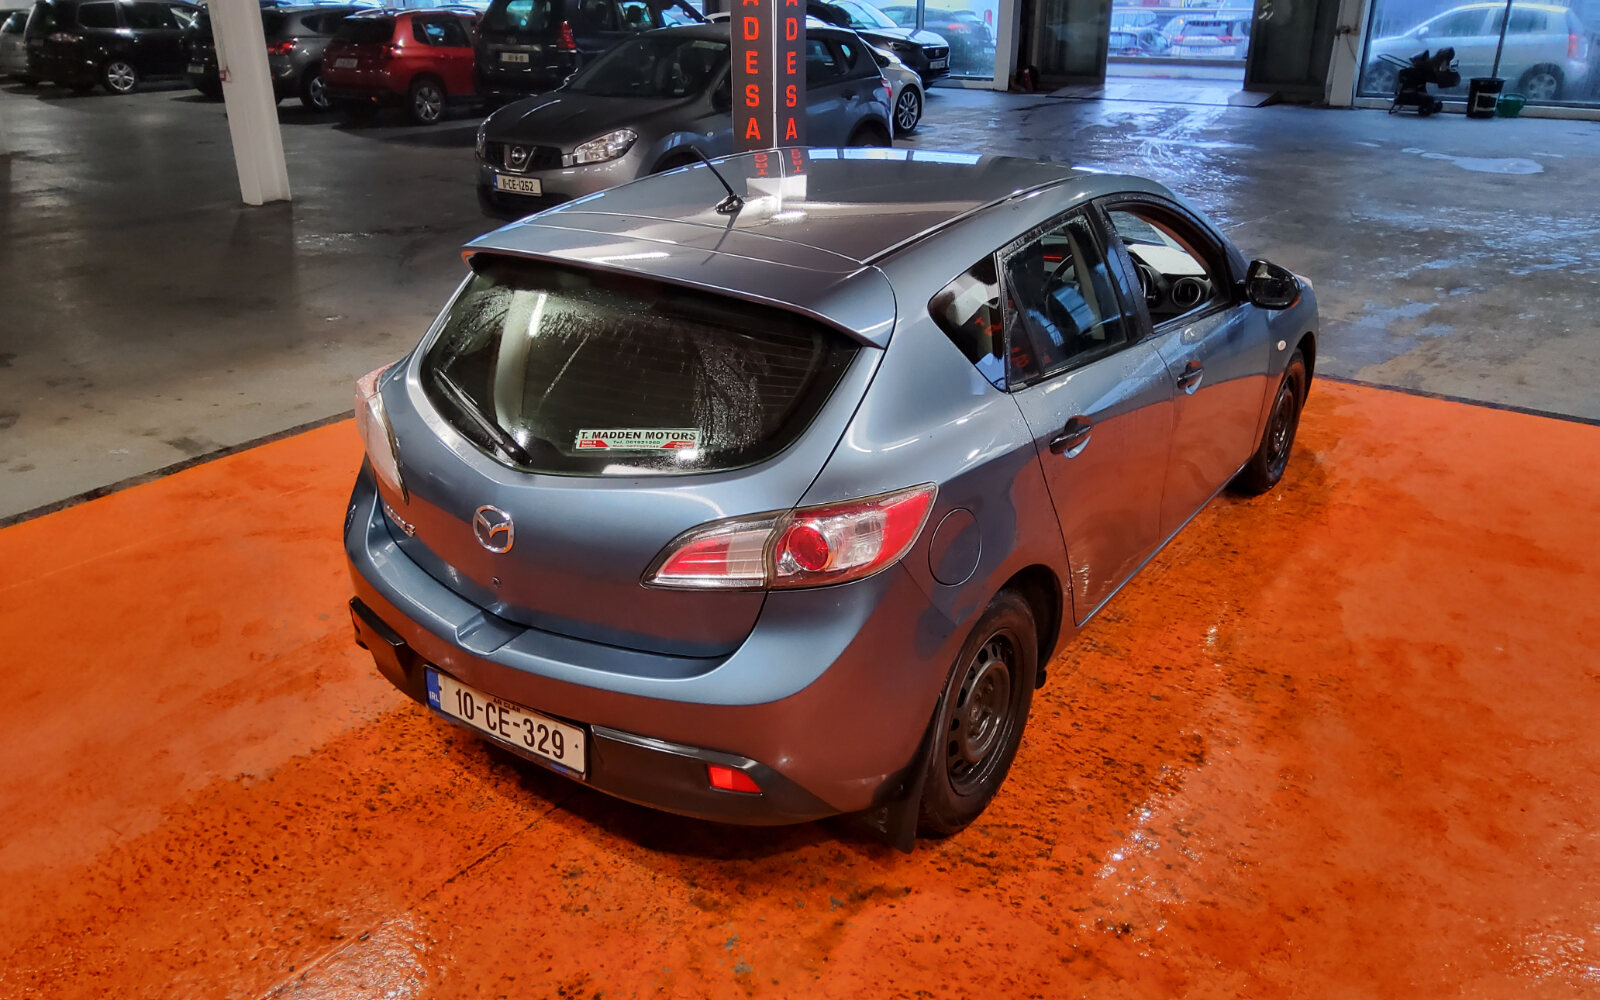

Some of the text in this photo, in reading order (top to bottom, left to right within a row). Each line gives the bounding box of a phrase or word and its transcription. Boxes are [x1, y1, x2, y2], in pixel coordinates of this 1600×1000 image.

[743, 0, 761, 140] DESA
[785, 0, 798, 140] DESA
[581, 431, 696, 441] T. MADDEN MOTORS
[429, 690, 440, 703] IRL
[456, 688, 565, 760] 10-CE-329
